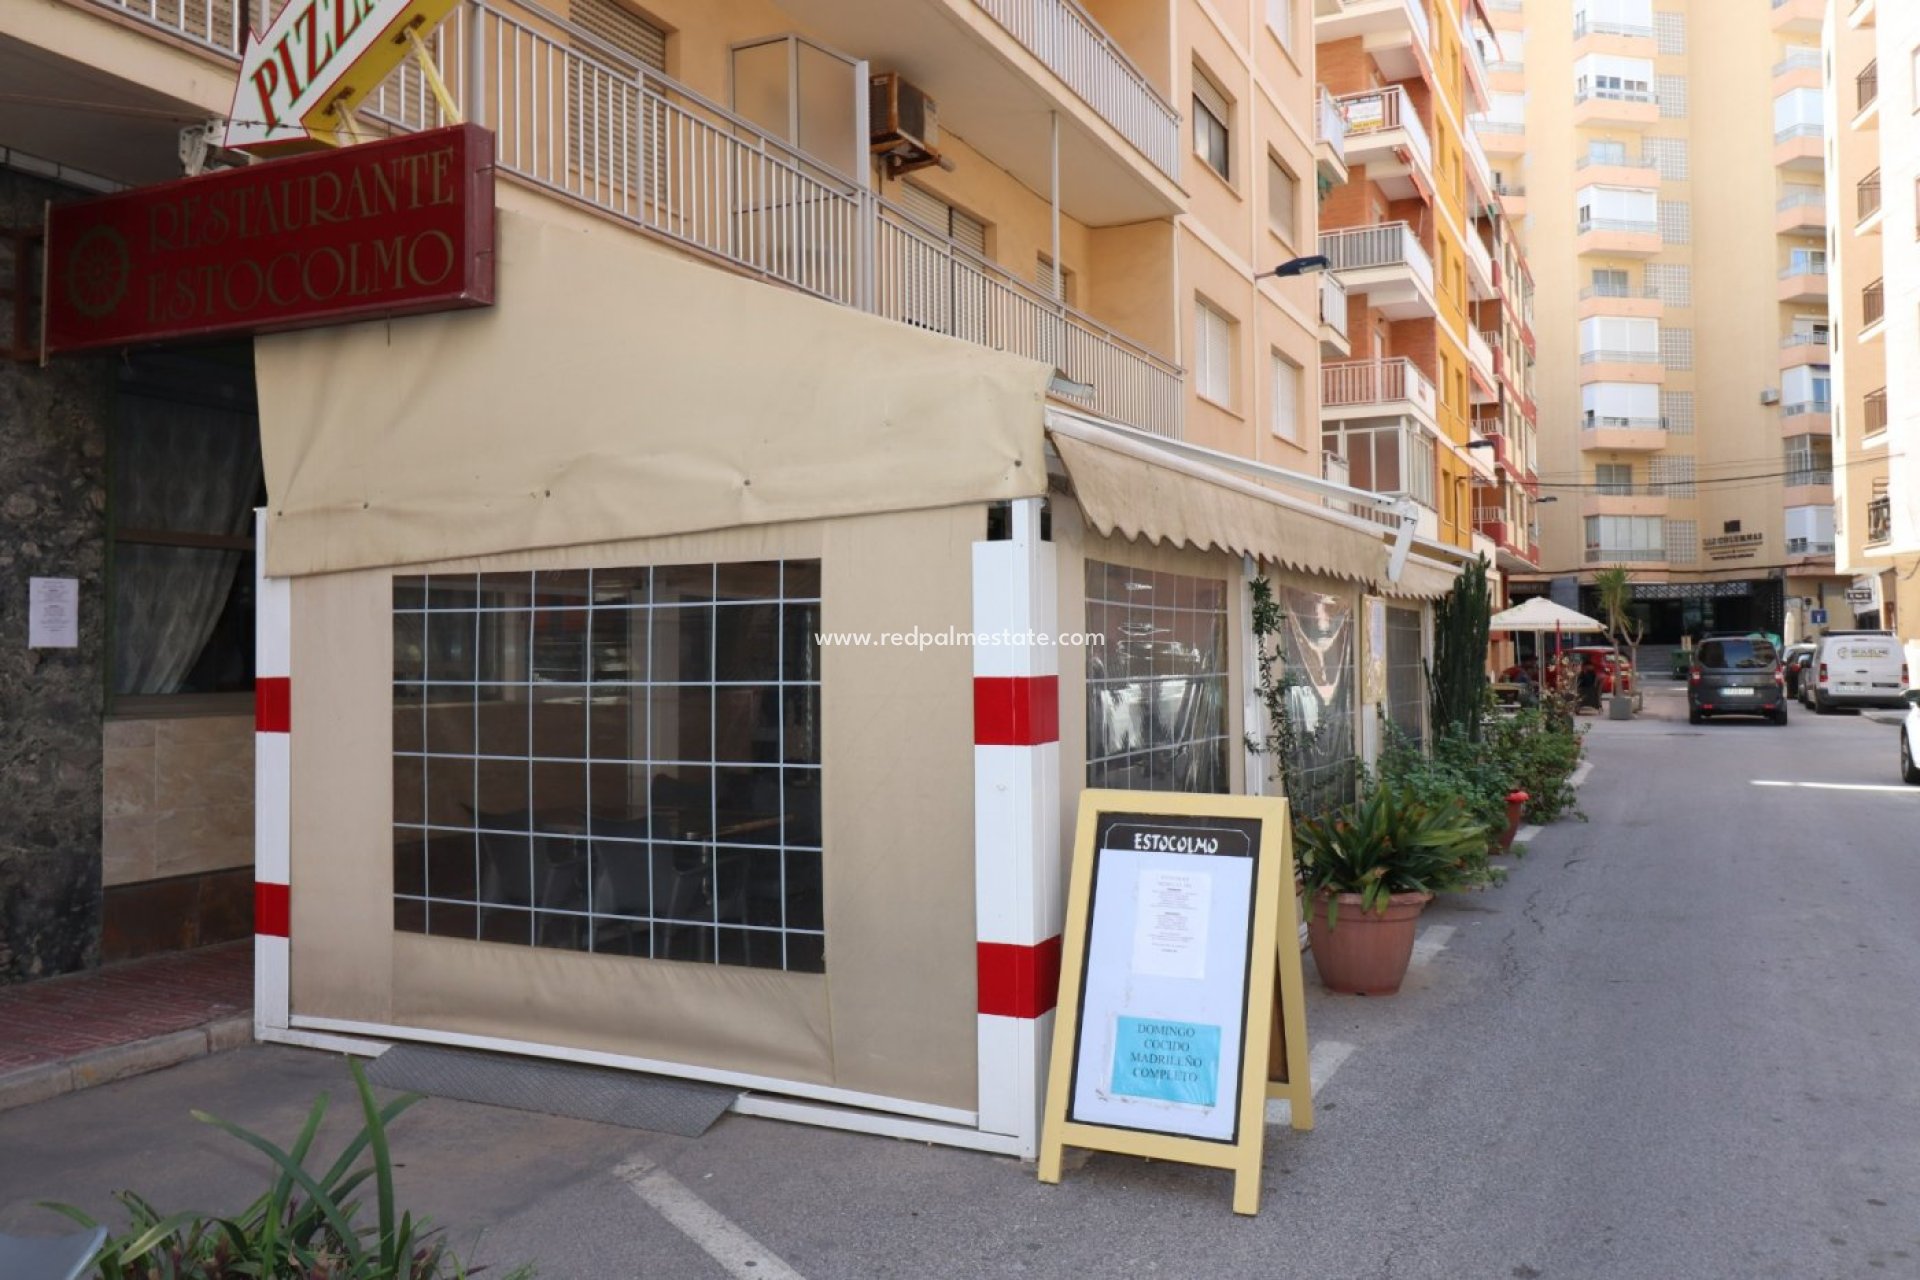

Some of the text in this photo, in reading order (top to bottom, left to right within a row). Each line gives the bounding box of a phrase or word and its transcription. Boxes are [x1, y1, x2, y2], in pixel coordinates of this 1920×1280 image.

[250, 0, 376, 138] PIZZ
[150, 147, 454, 256] RESTAURANTE
[145, 230, 455, 323] ESTOCOLMO
[1134, 832, 1219, 854] ESTOCOLMO
[1137, 1024, 1196, 1038] DOMINGO
[1143, 1039, 1191, 1052] COCIDO
[1132, 1067, 1199, 1082] COMPLETO
